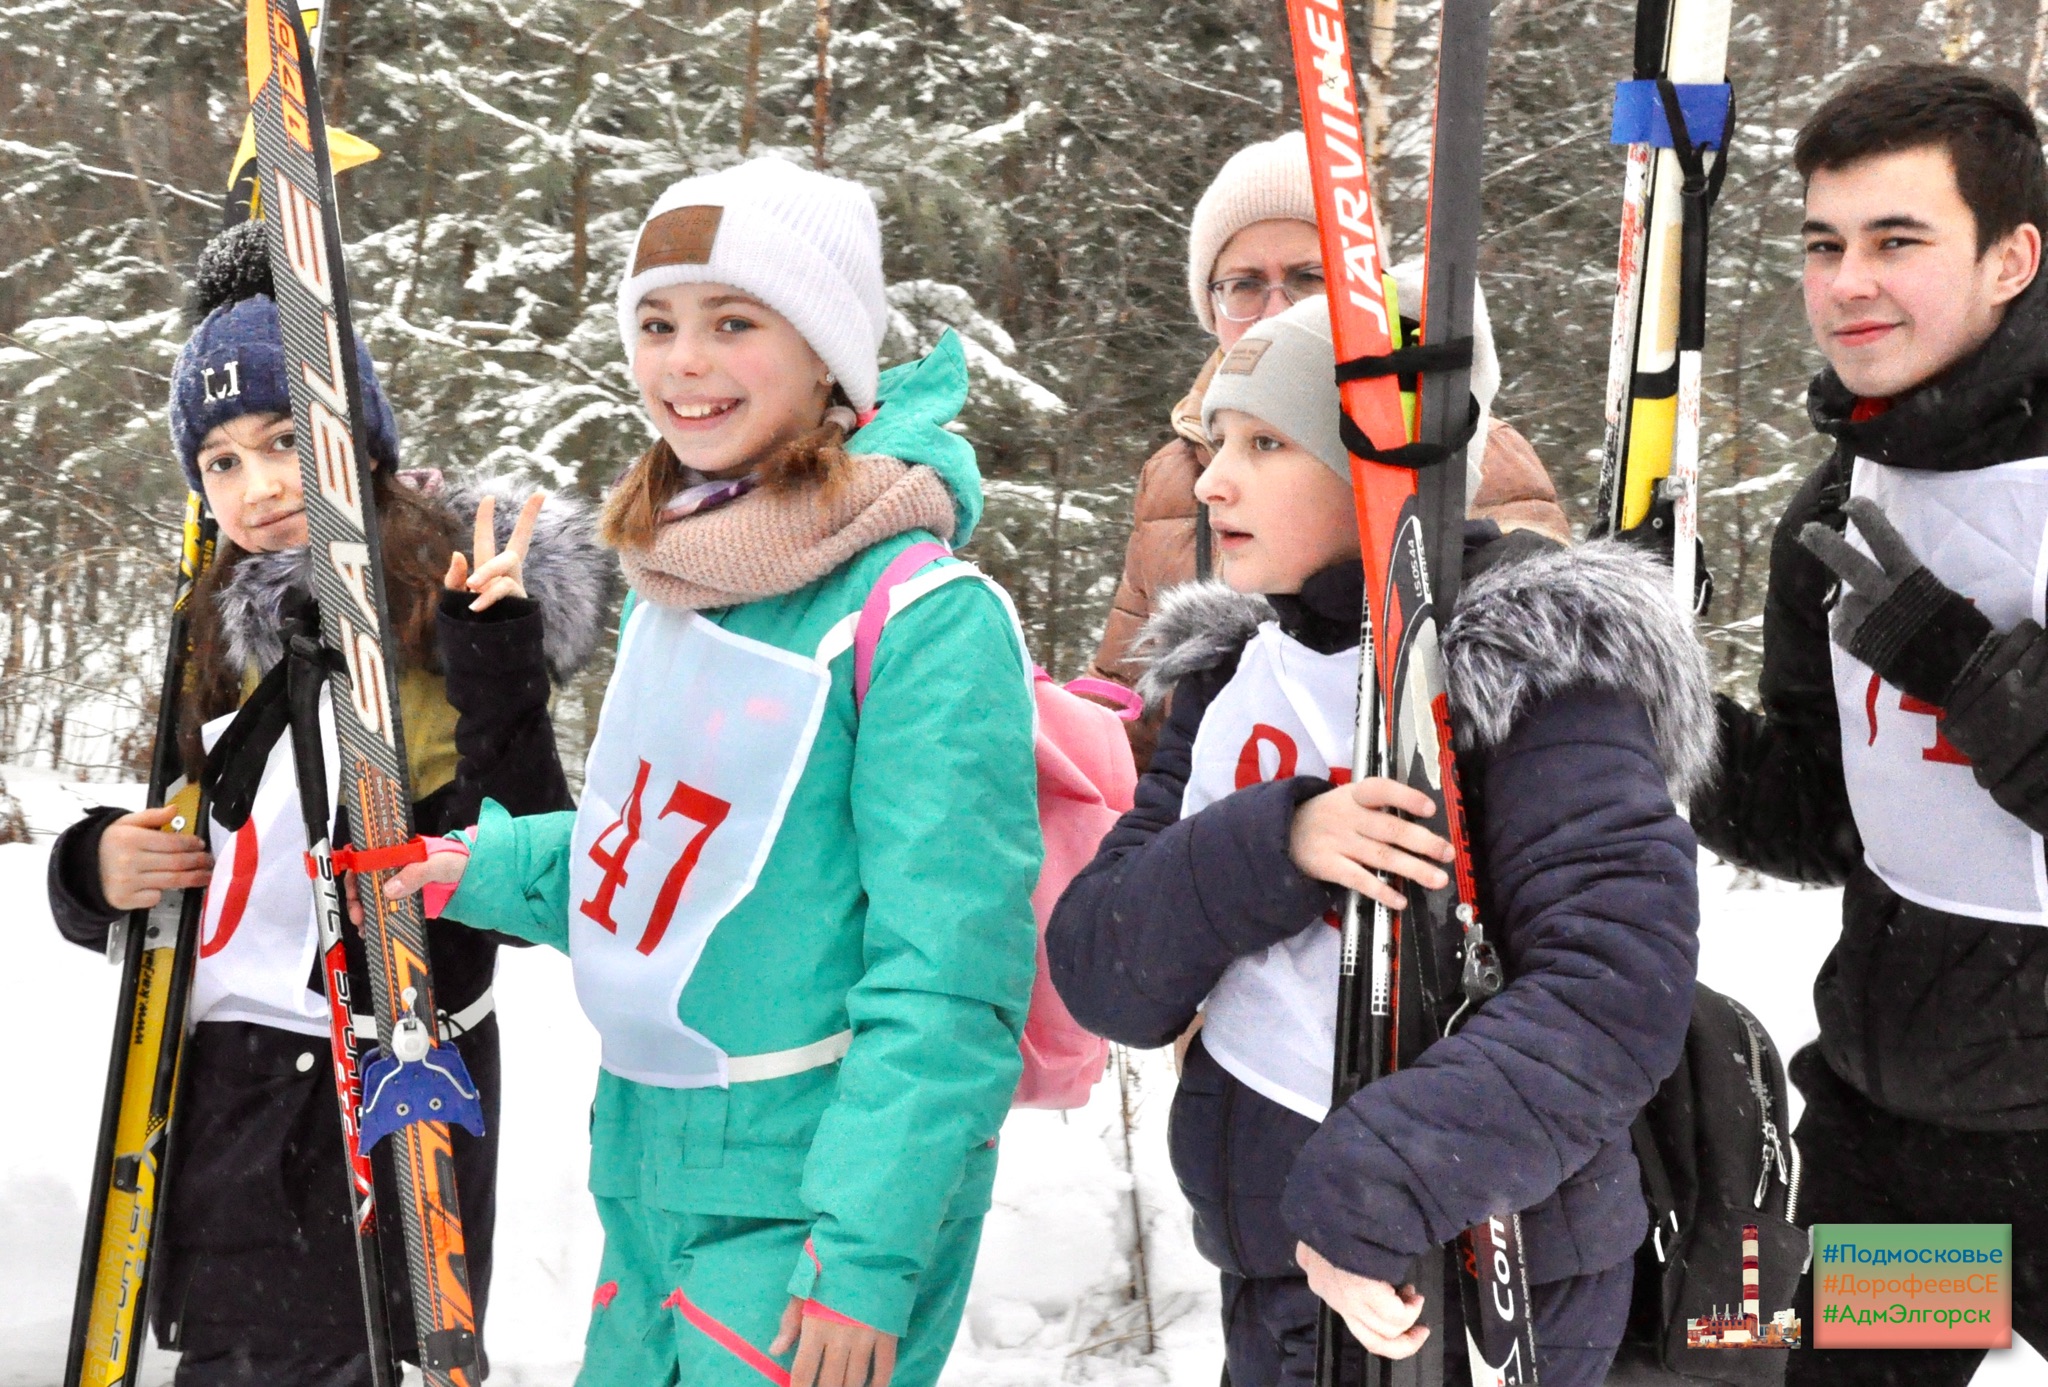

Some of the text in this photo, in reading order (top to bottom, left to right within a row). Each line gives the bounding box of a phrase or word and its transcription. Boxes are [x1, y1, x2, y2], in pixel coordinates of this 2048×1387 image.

[1305, 0, 1389, 335] JÄRVINE
[275, 168, 396, 752] SABLE
[579, 755, 732, 957] 47
